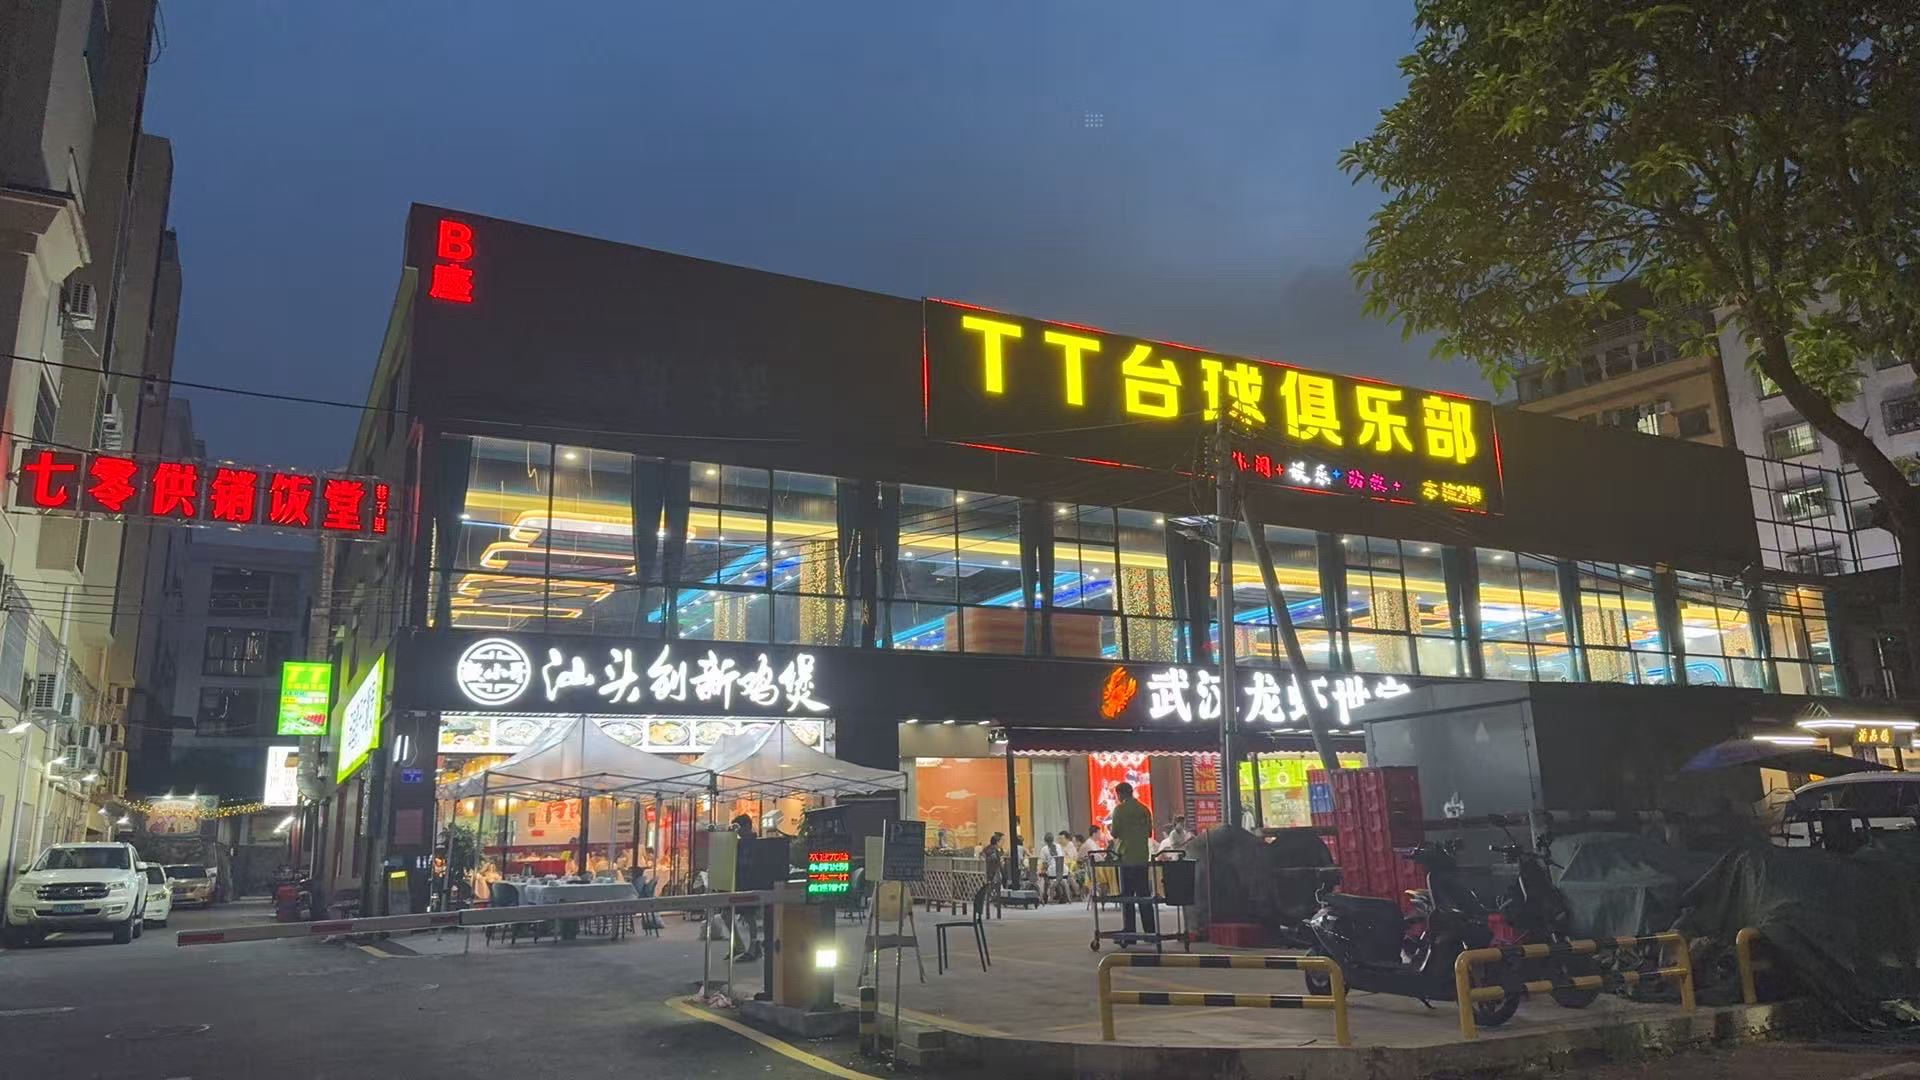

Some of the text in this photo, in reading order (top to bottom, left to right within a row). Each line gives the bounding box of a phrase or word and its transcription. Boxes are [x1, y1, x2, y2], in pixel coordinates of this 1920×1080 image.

[962, 315, 1477, 465] TT台球俱乐部
[26, 449, 366, 530] 七零供销饭堂
[540, 645, 830, 714] 汕头创新鸡煲
